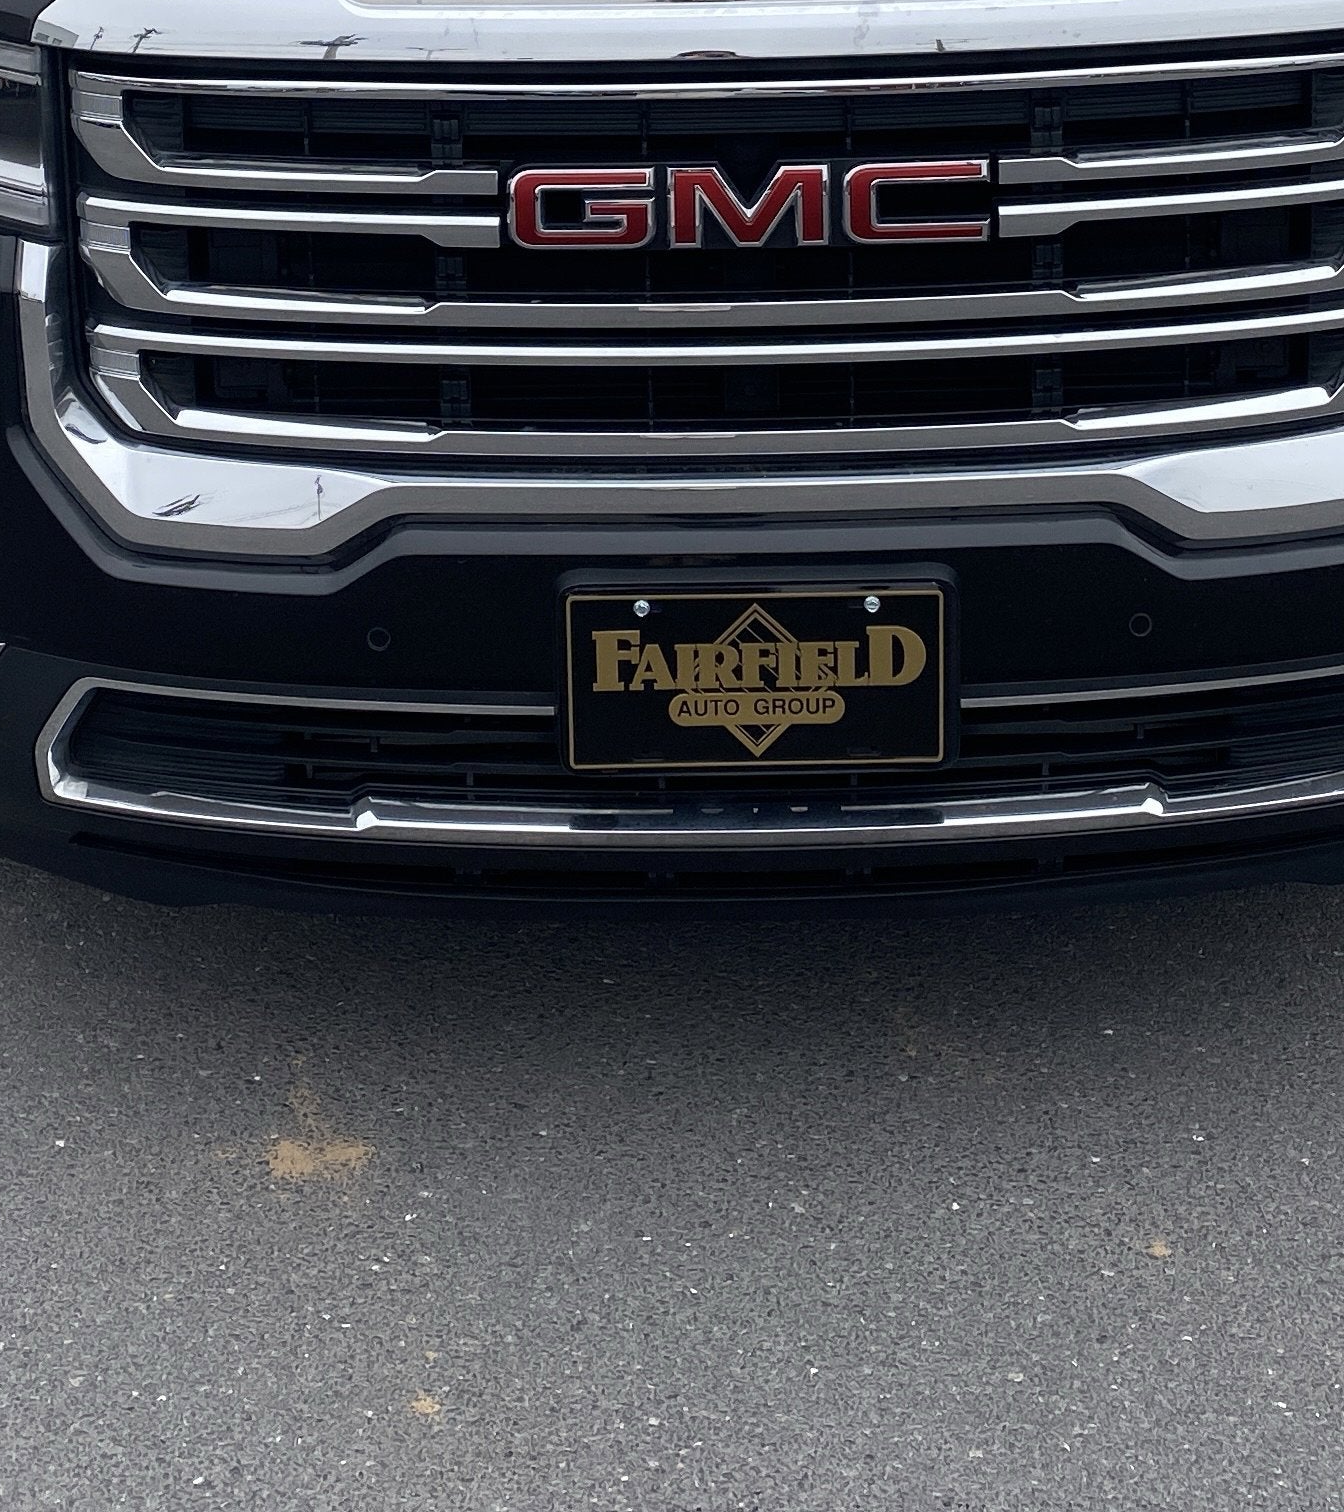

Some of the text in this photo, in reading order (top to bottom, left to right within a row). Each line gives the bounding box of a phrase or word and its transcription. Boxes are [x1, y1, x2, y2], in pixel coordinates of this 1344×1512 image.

[508, 160, 990, 250] GMC
[591, 625, 927, 692] FAIRFIELD
[677, 697, 836, 717] AUTO GROUP
